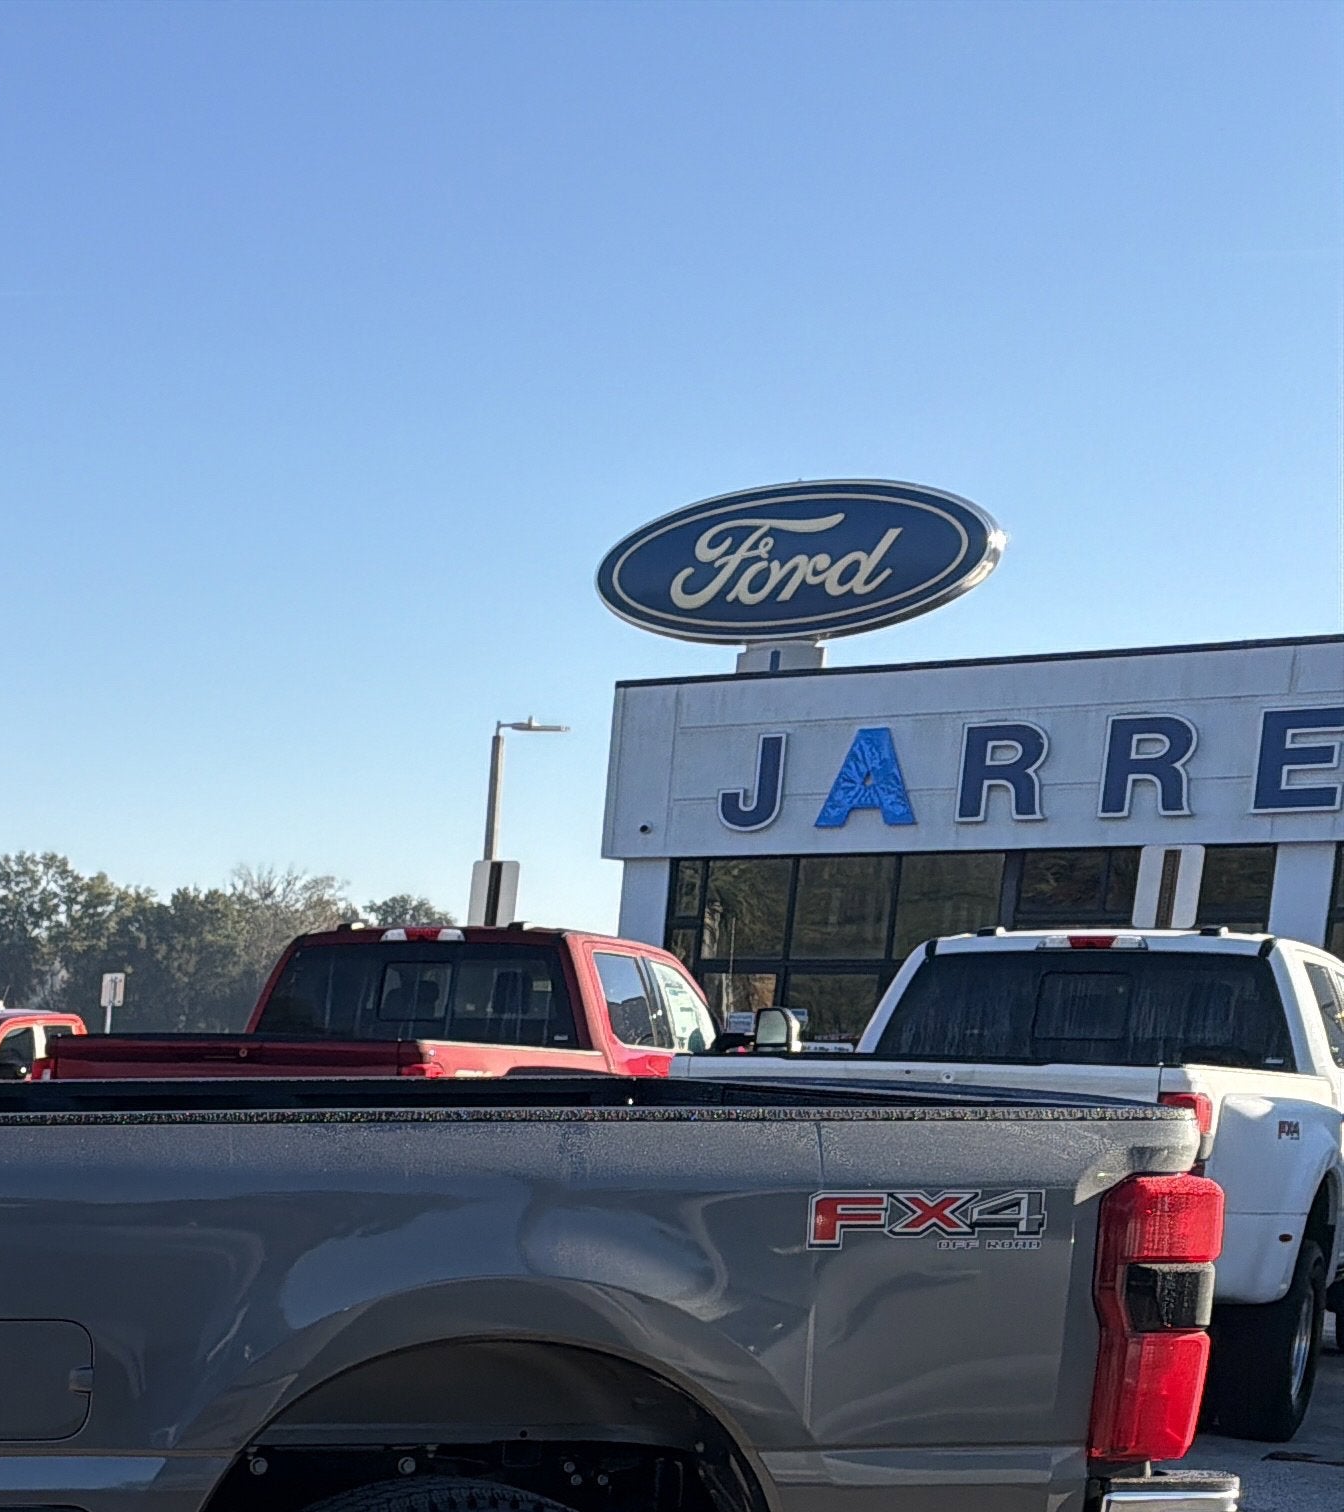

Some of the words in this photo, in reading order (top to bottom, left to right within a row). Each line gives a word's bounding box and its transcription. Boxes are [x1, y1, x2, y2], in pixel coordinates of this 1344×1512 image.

[670, 512, 903, 610] Ford
[807, 1189, 1047, 1250] FX4
[937, 1240, 979, 1250] OFF
[985, 1240, 1042, 1250] ROAD
